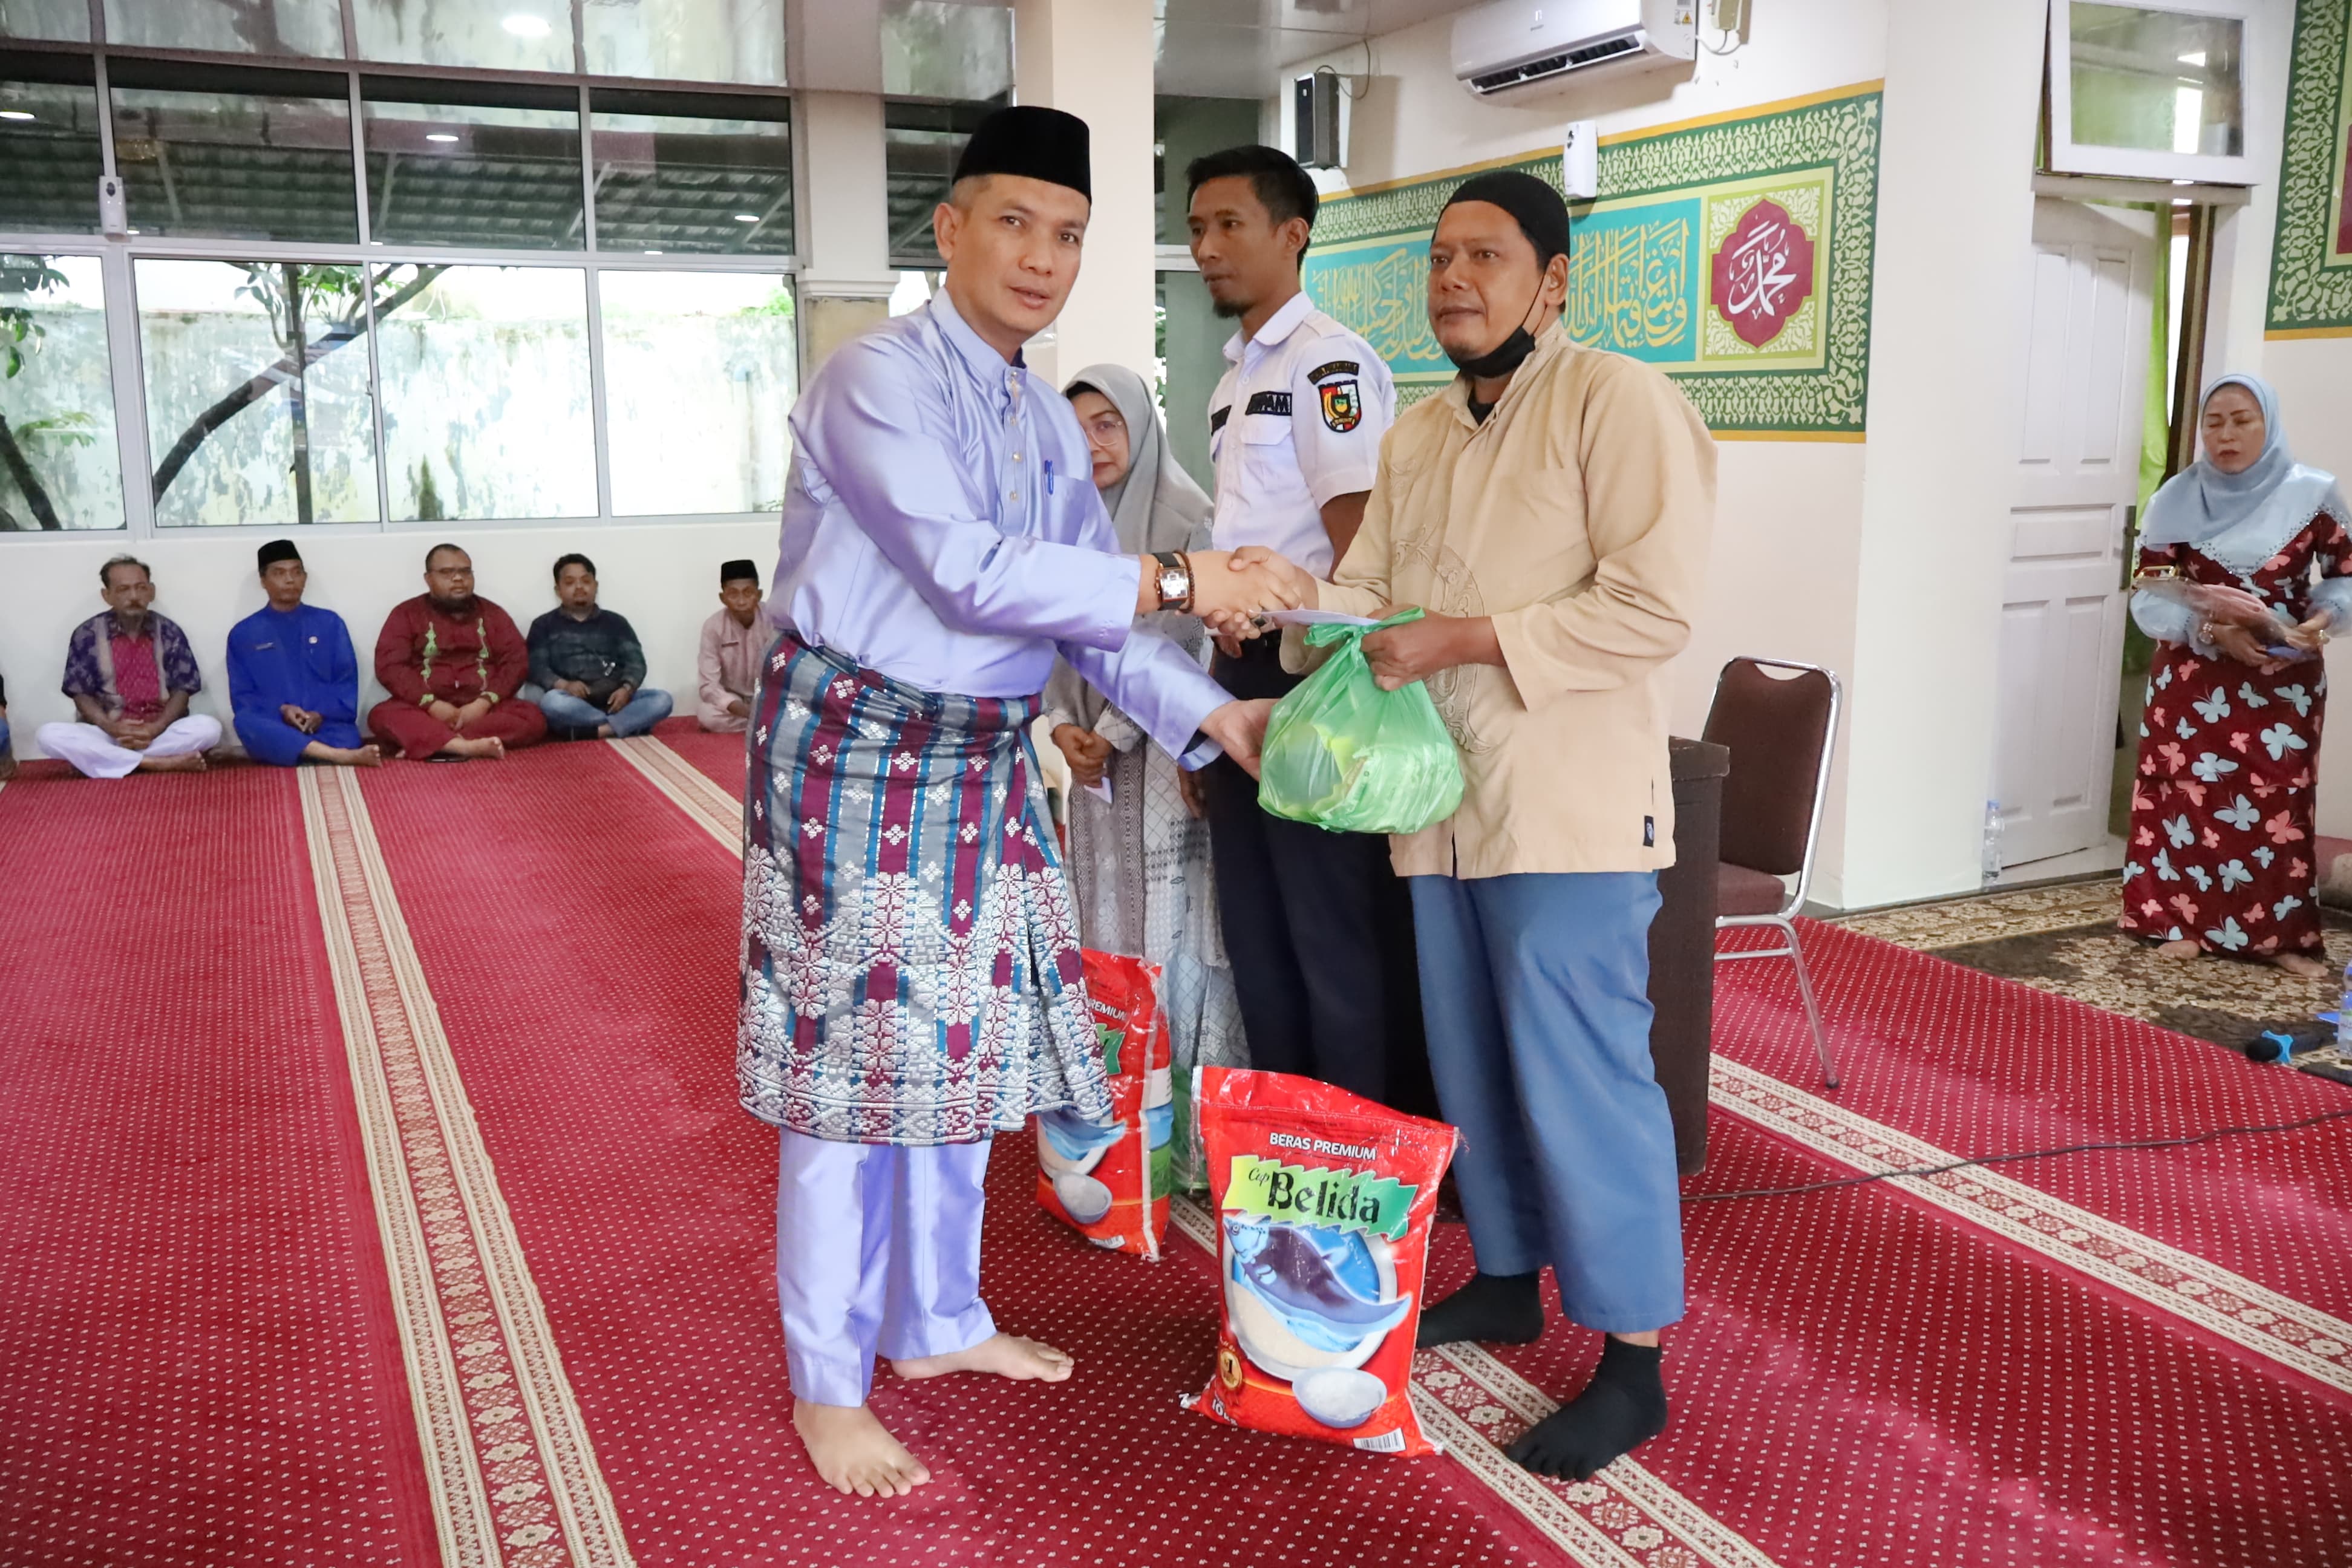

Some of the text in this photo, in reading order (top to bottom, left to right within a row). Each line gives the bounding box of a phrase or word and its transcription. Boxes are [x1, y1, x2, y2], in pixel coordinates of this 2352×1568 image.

[1089, 999, 1128, 1021] REMIUM
[1270, 1132, 1376, 1160] BERAS PREMIUM
[1268, 1171, 1380, 1224] Belida
